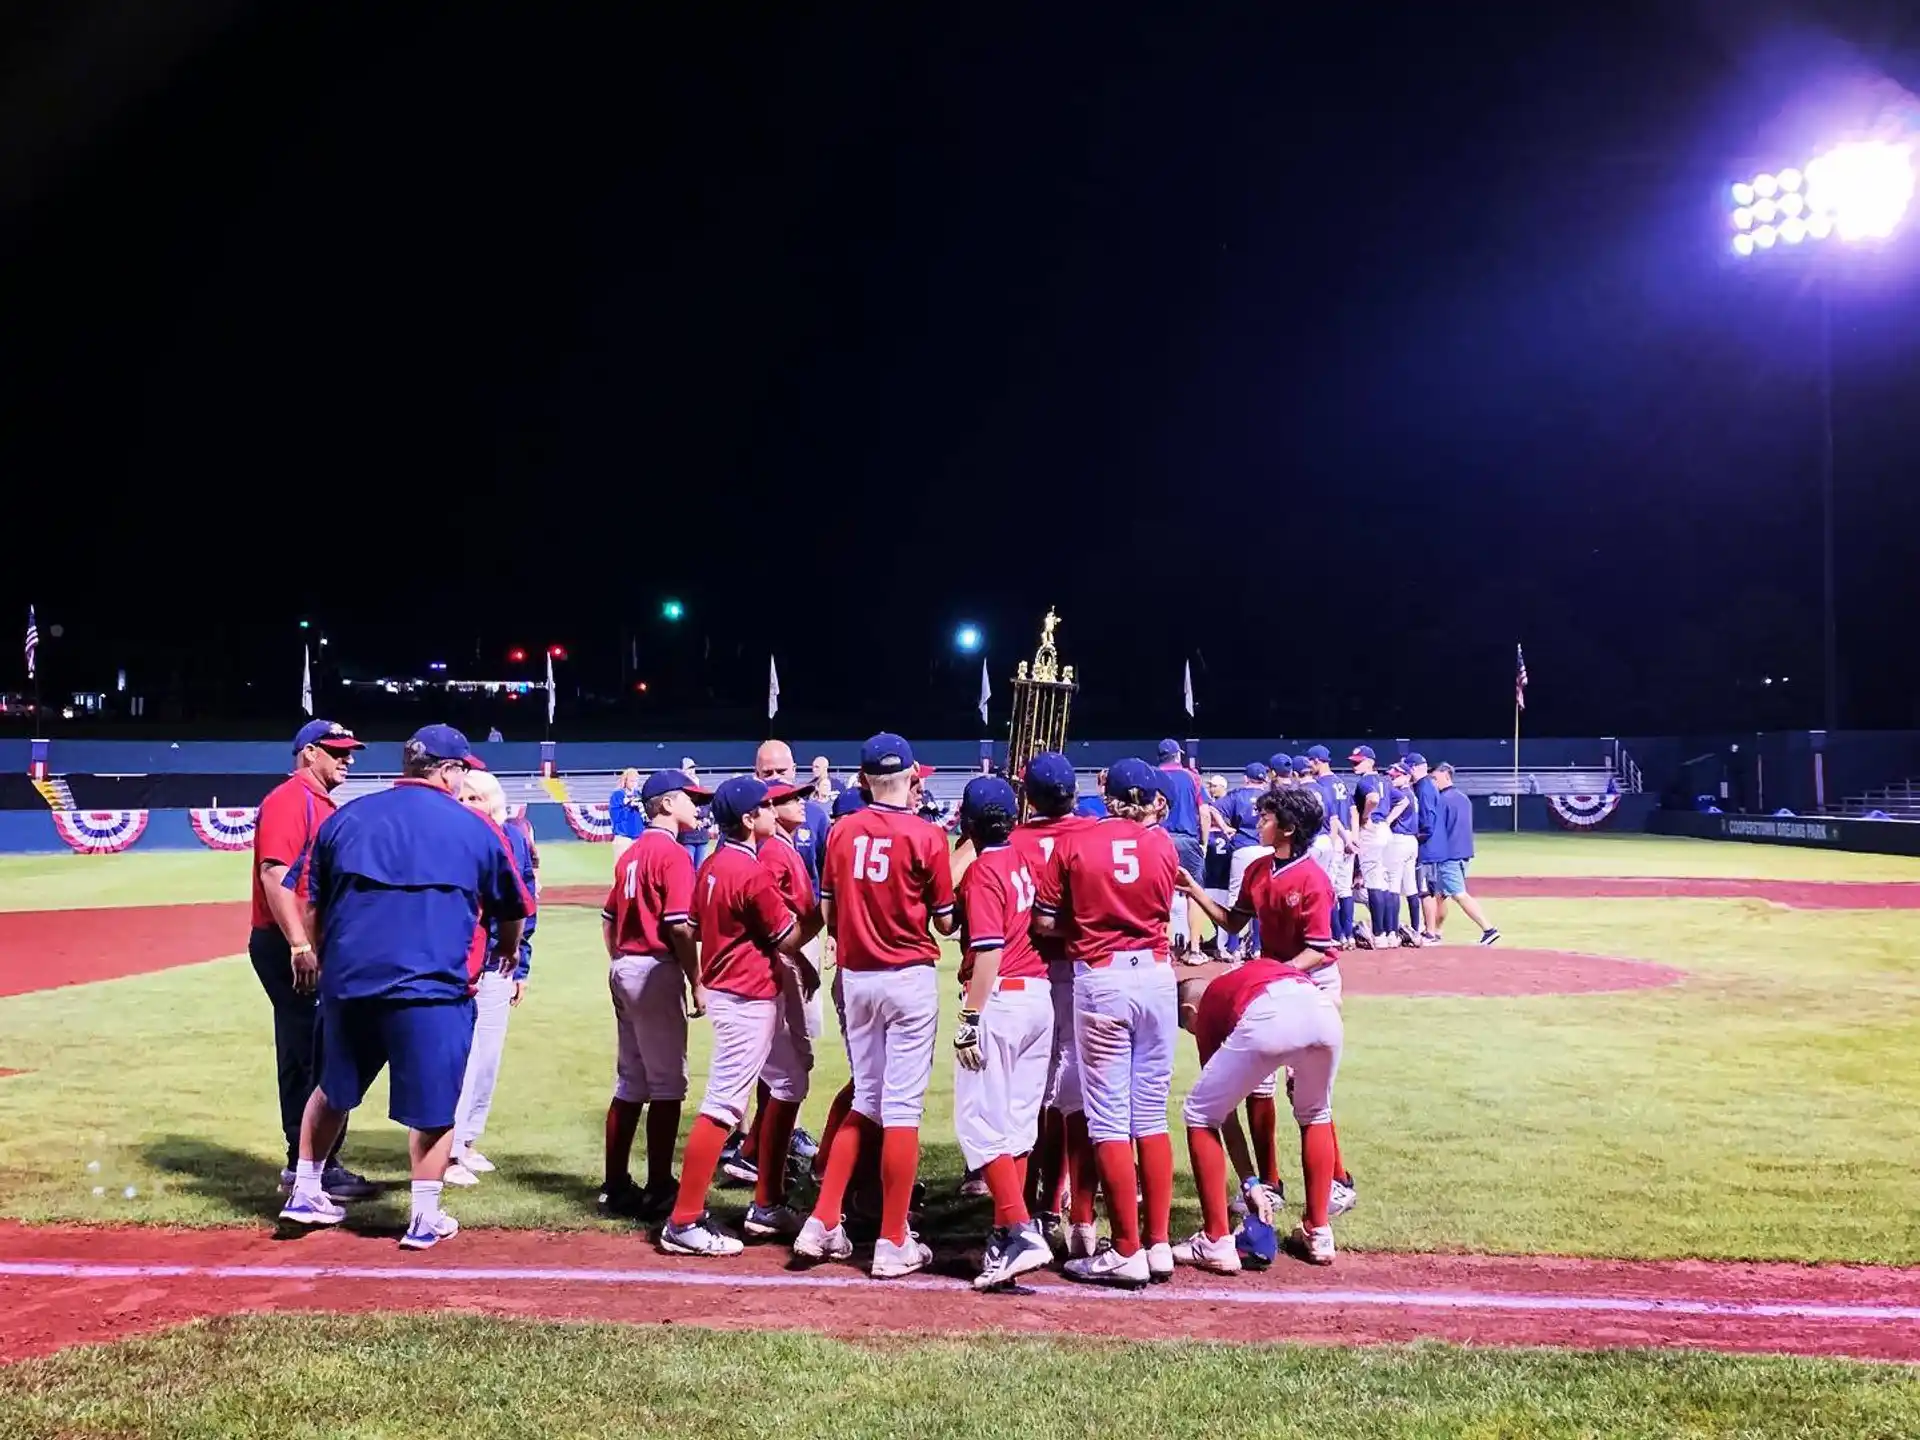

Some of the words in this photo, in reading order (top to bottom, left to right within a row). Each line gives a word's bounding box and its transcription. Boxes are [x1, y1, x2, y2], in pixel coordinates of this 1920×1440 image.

[1332, 782, 1348, 800] 12
[1489, 795, 1512, 807] 200
[1215, 837, 1227, 855] 2
[853, 835, 892, 883] 15
[1111, 839, 1140, 884] 5
